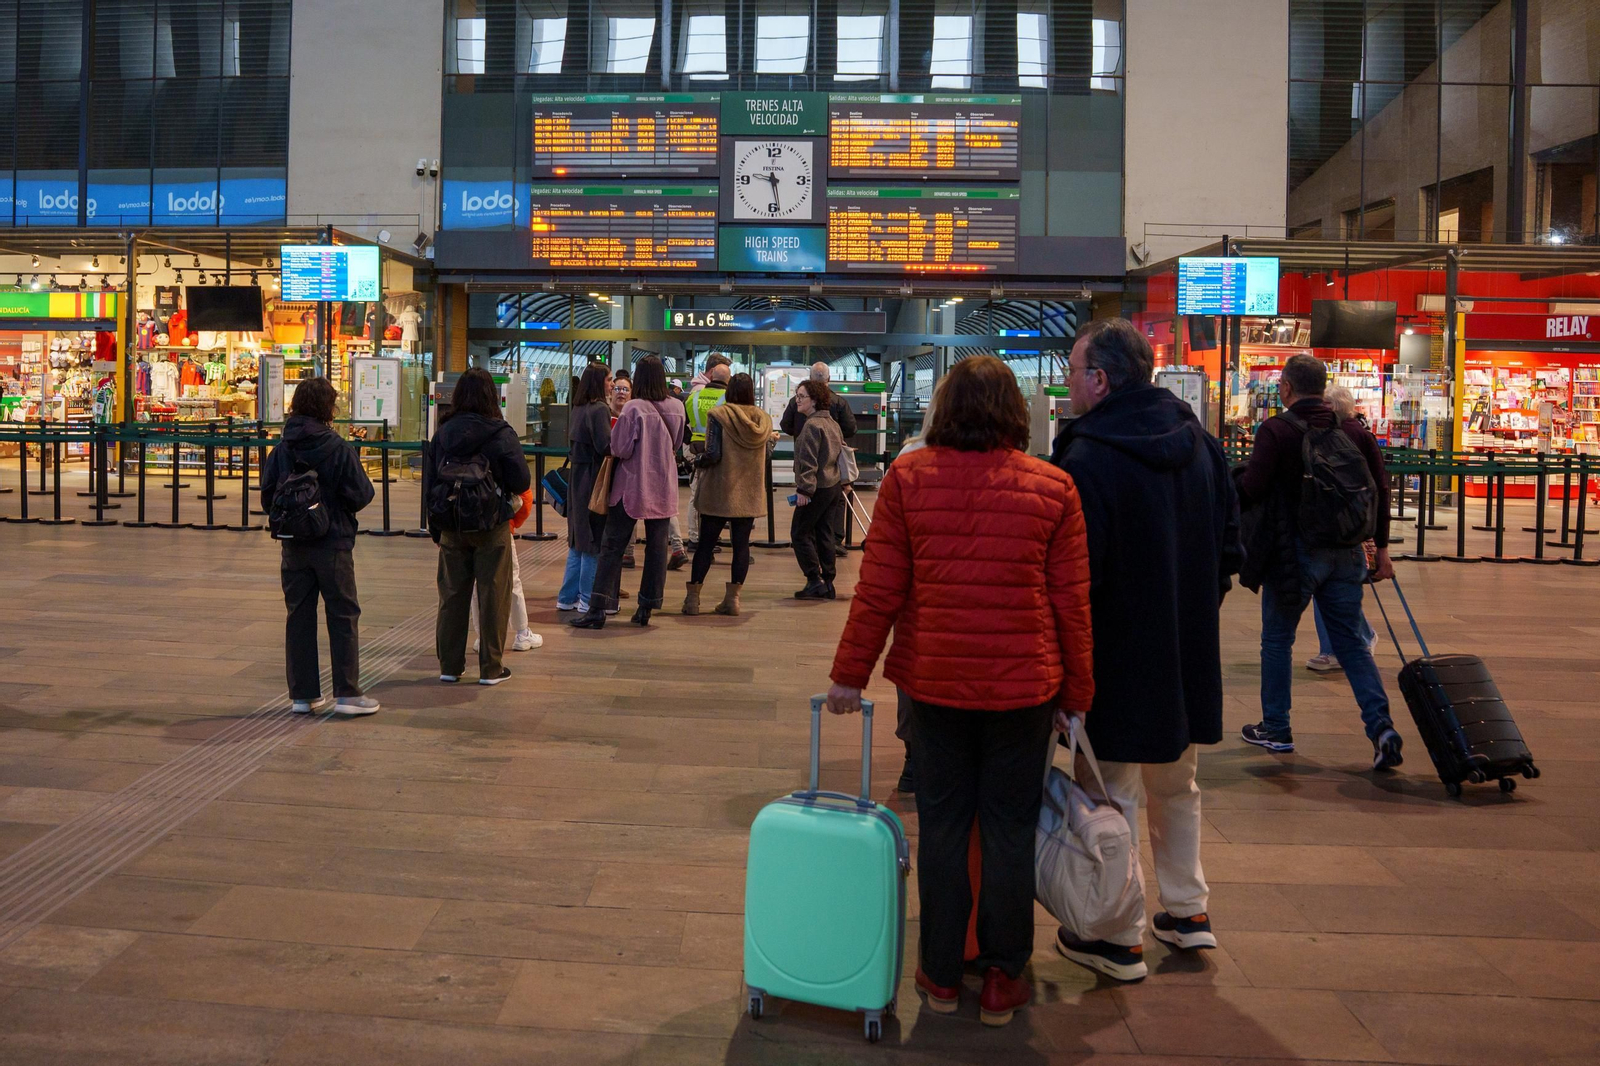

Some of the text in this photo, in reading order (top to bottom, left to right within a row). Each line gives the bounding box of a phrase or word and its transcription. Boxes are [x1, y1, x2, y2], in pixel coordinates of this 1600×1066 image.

[745, 99, 804, 112] TRENES ALTA
[750, 113, 799, 126] VELOCIDAD
[766, 148, 782, 158] 12
[740, 175, 750, 185] 9
[796, 175, 806, 186] 3
[768, 202, 778, 213] 6
[744, 236, 800, 249] HIGH SPEED
[756, 250, 788, 262] TRAINS
[688, 312, 696, 326] 1
[706, 312, 715, 327] 6
[718, 312, 734, 321] Vías
[1546, 316, 1589, 338] RELAY
